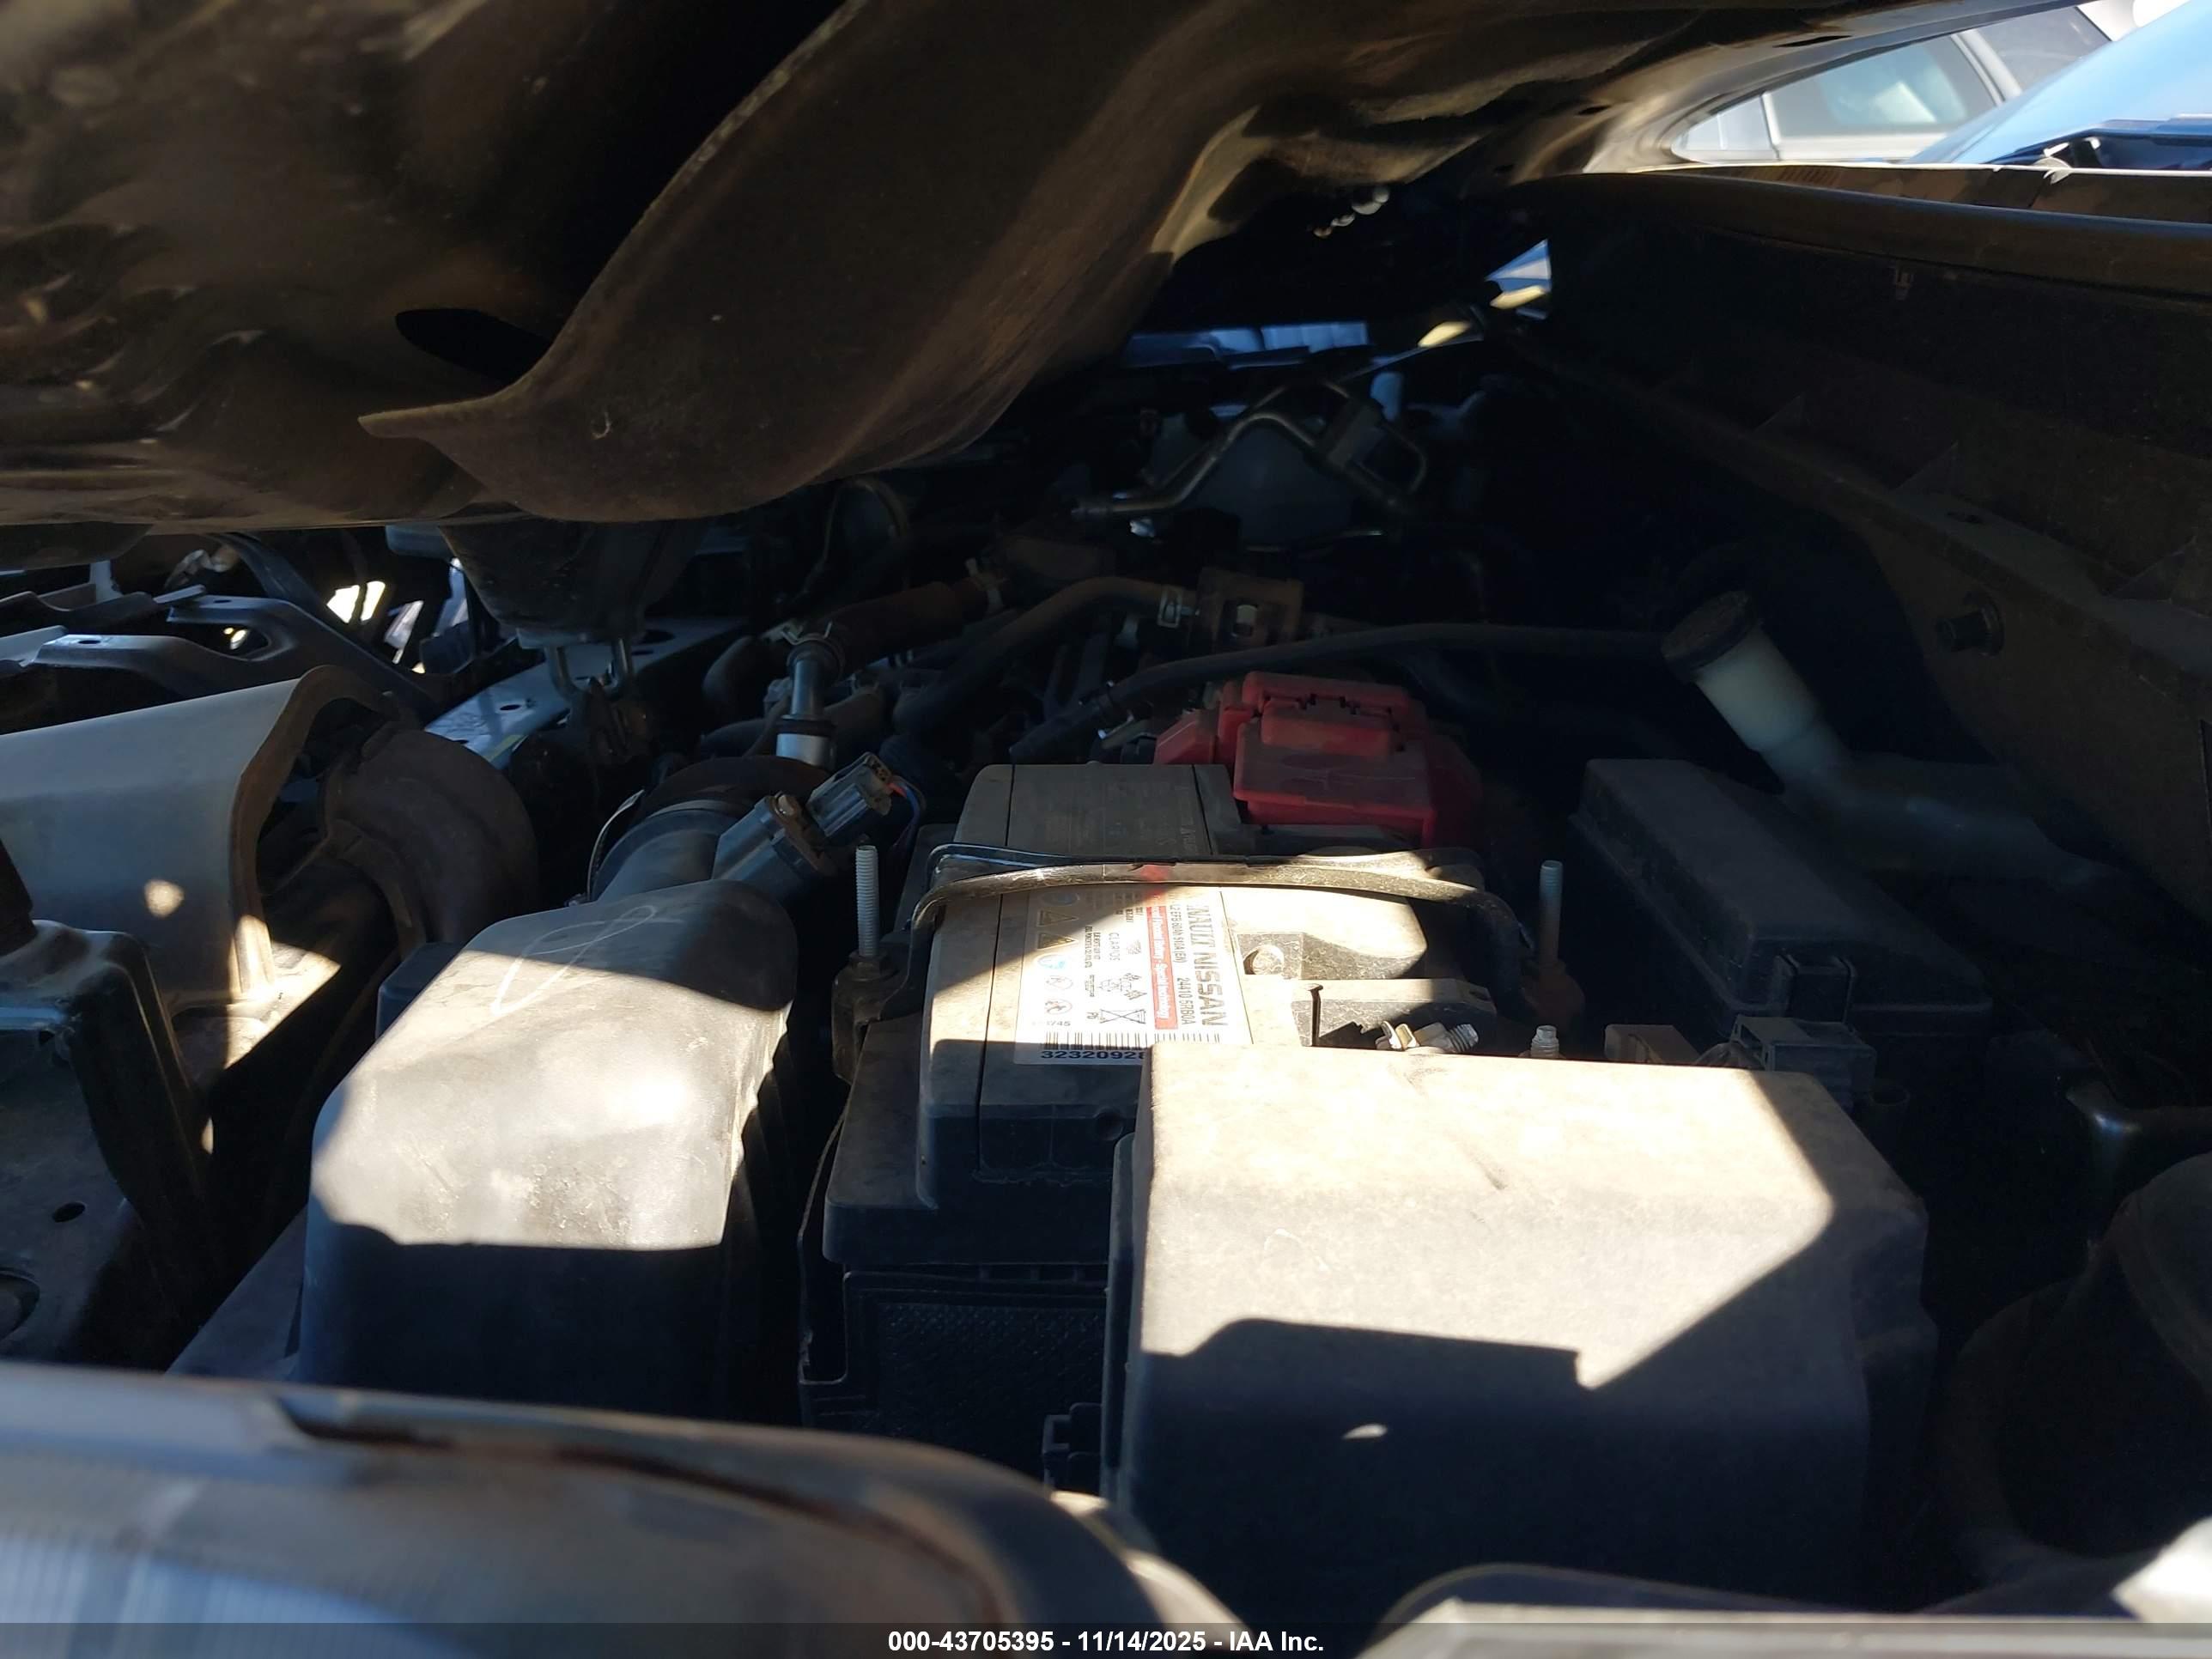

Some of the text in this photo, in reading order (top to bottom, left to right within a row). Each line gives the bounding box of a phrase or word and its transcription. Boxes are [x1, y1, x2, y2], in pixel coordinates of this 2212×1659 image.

[1173, 951, 1188, 963] (EN)
[1187, 905, 1228, 1025] NAULT NISSAN
[1177, 977, 1193, 998] 24410
